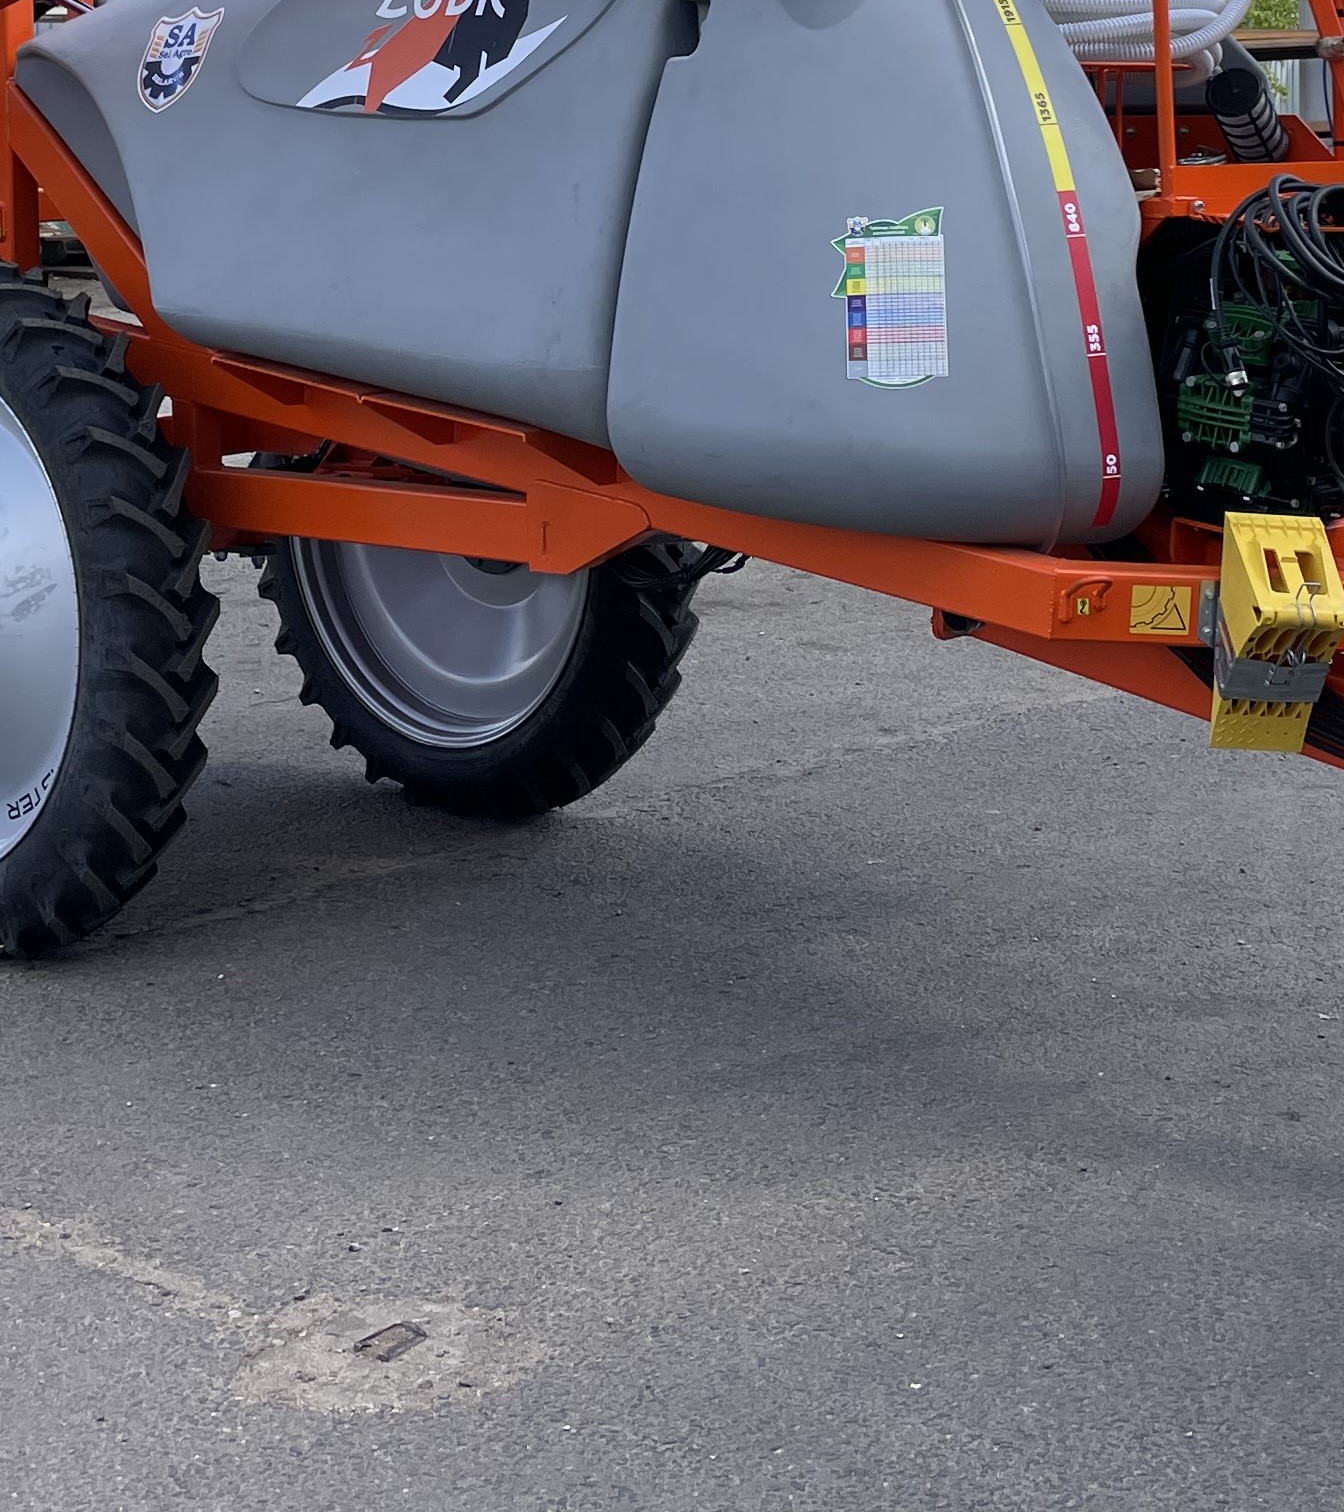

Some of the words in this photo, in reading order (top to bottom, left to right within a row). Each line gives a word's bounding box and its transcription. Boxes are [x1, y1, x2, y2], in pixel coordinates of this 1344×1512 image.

[163, 22, 197, 49] SA
[174, 49, 193, 59] Agro
[1035, 92, 1051, 122] 1365
[1064, 203, 1080, 232] 840
[1087, 324, 1101, 352] 355
[1106, 454, 1117, 474] 50
